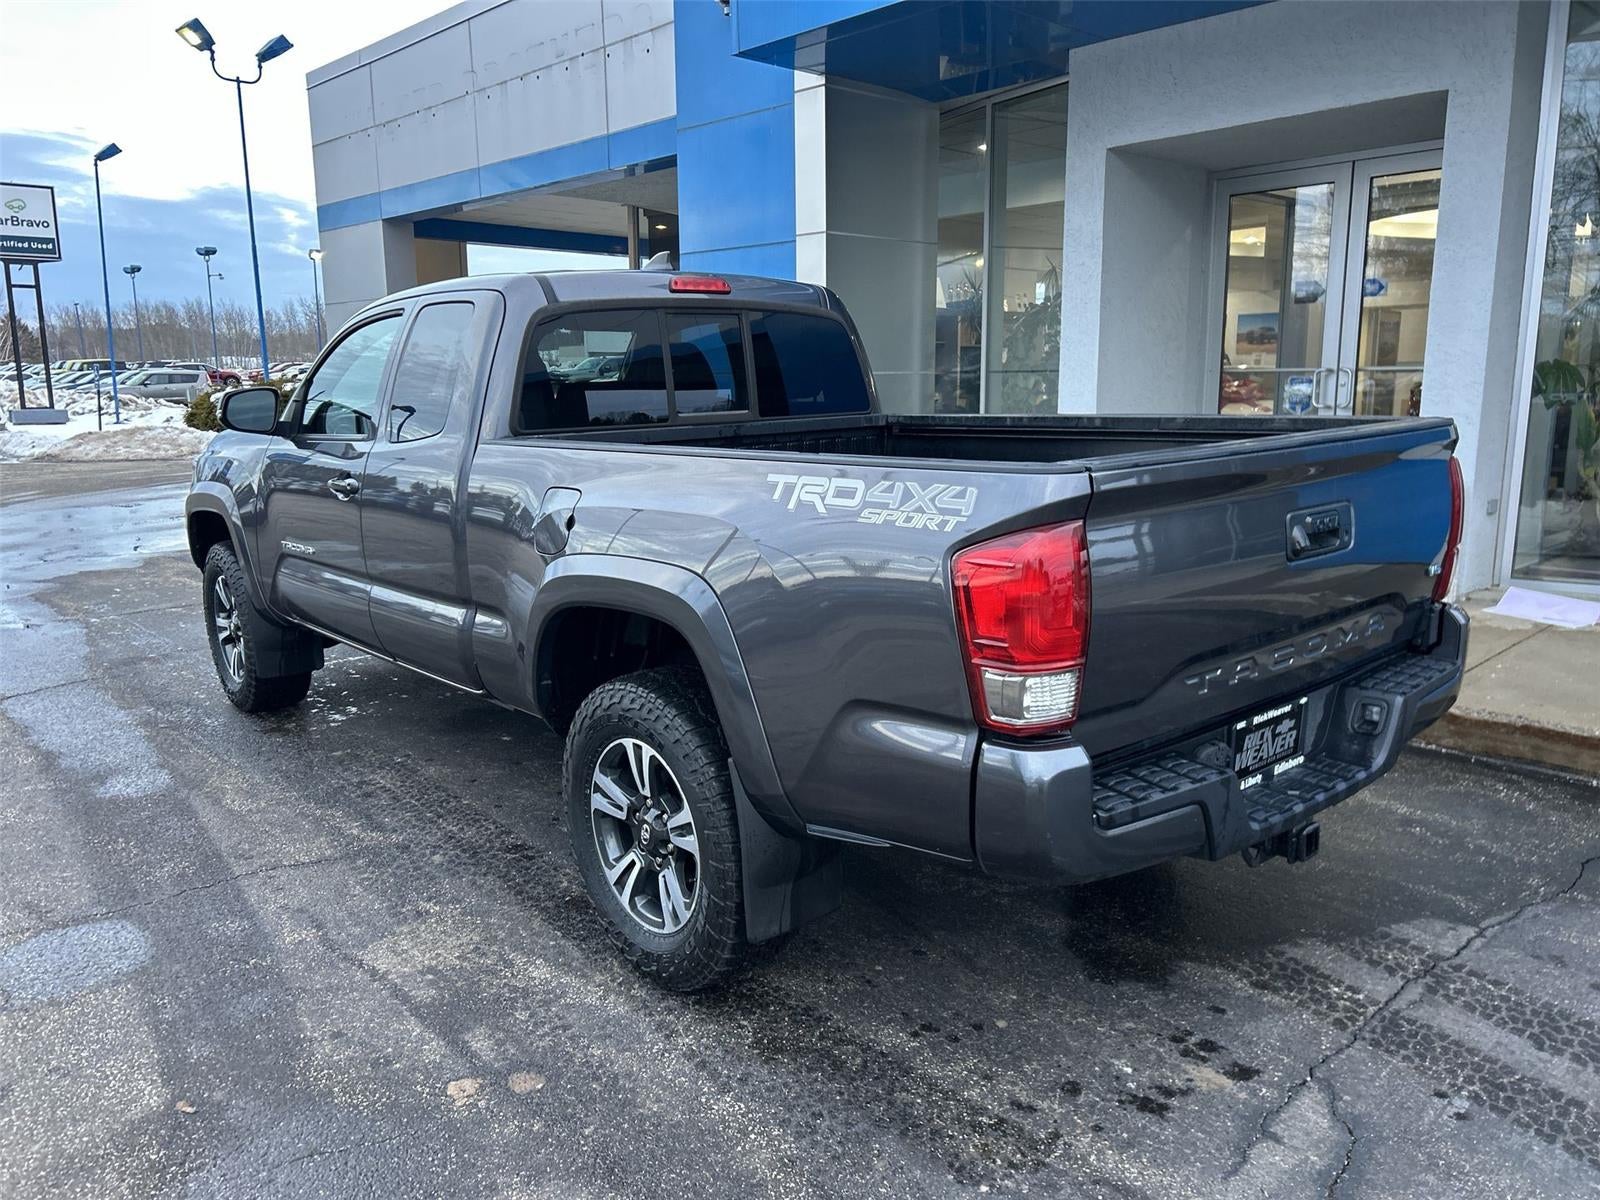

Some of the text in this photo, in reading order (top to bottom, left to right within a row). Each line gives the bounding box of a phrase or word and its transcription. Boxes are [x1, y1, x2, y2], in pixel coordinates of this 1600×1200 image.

[31, 241, 53, 249] Used
[767, 473, 866, 516] TRD
[857, 508, 968, 532] SPORT
[1235, 730, 1297, 772] WEAVER
[1243, 725, 1274, 752] RICK
